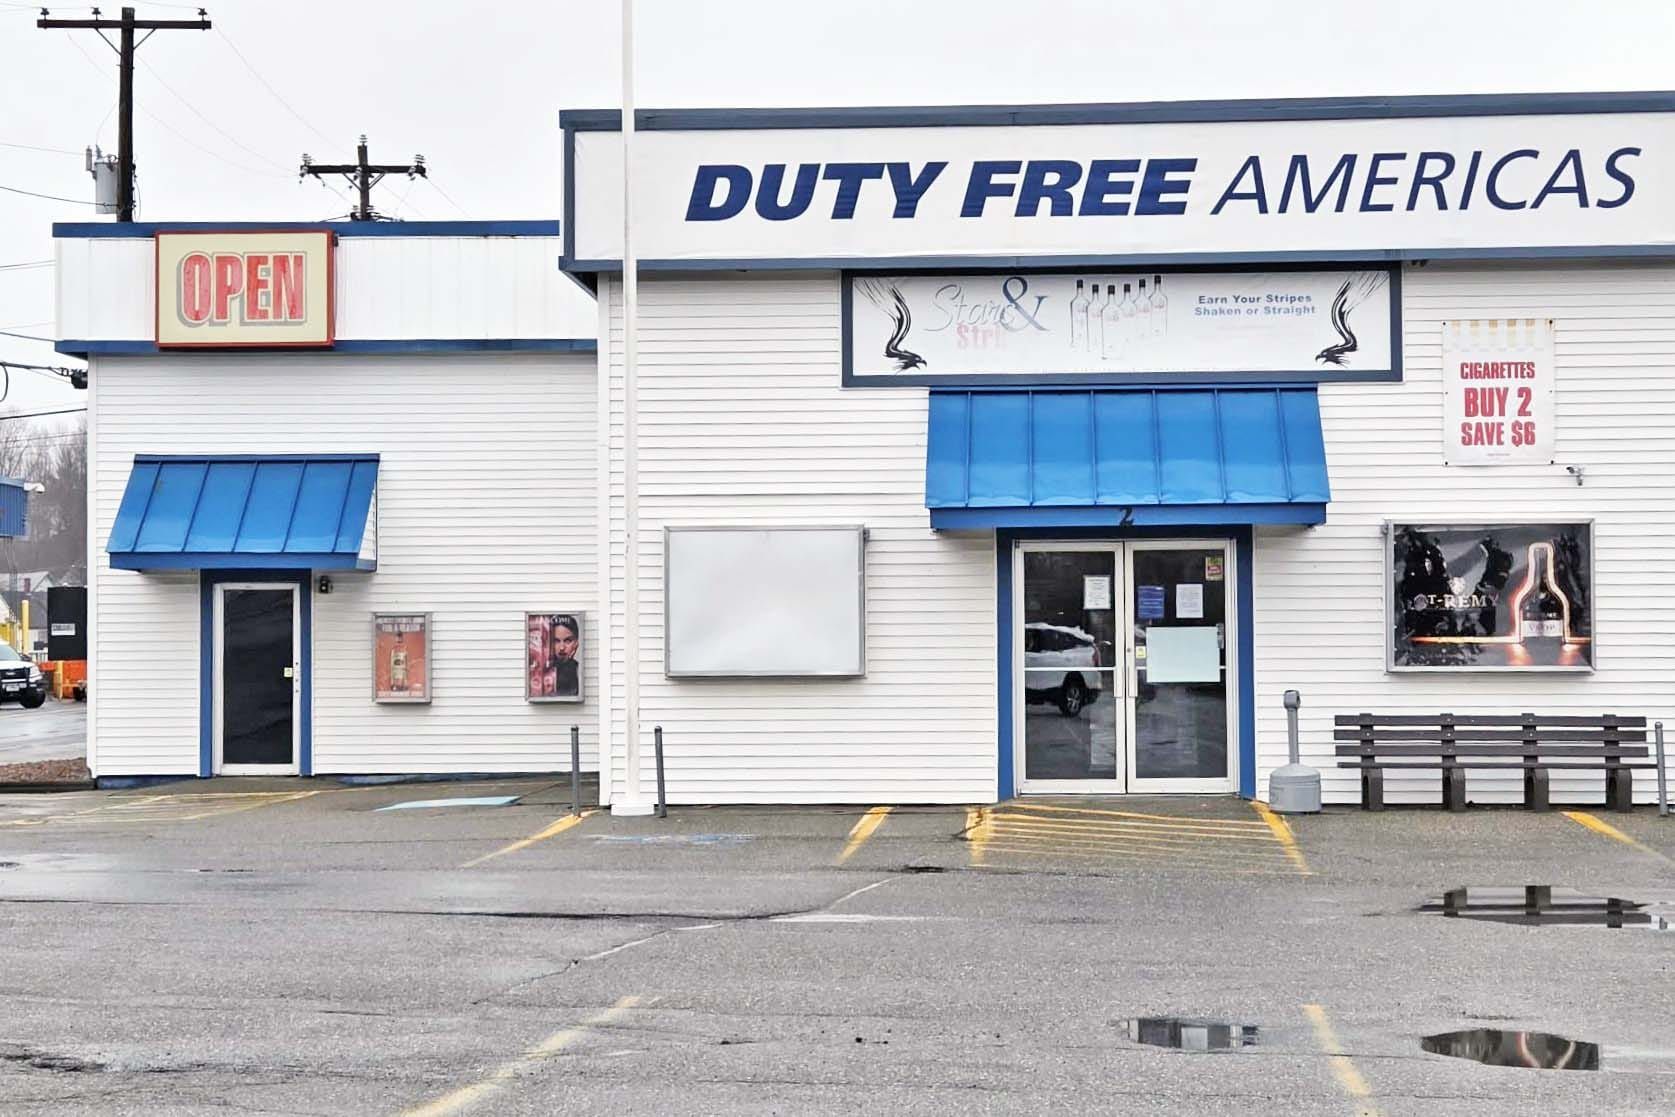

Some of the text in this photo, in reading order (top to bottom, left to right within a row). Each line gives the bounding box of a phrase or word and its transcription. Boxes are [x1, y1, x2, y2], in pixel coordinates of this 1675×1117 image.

[686, 146, 1641, 221] DUTY FREE AMERICAS
[177, 251, 307, 327] OPEN
[1199, 294, 1312, 304] Earn Your Stripes
[1002, 276, 1051, 331] &
[1194, 306, 1316, 317] Shaken or Straight
[1460, 362, 1536, 380] CIGARETTES
[1464, 387, 1532, 417] BUY 2
[1461, 420, 1536, 447] SAVE $6
[1119, 507, 1134, 526] 2
[1414, 593, 1500, 611] T-REMY
